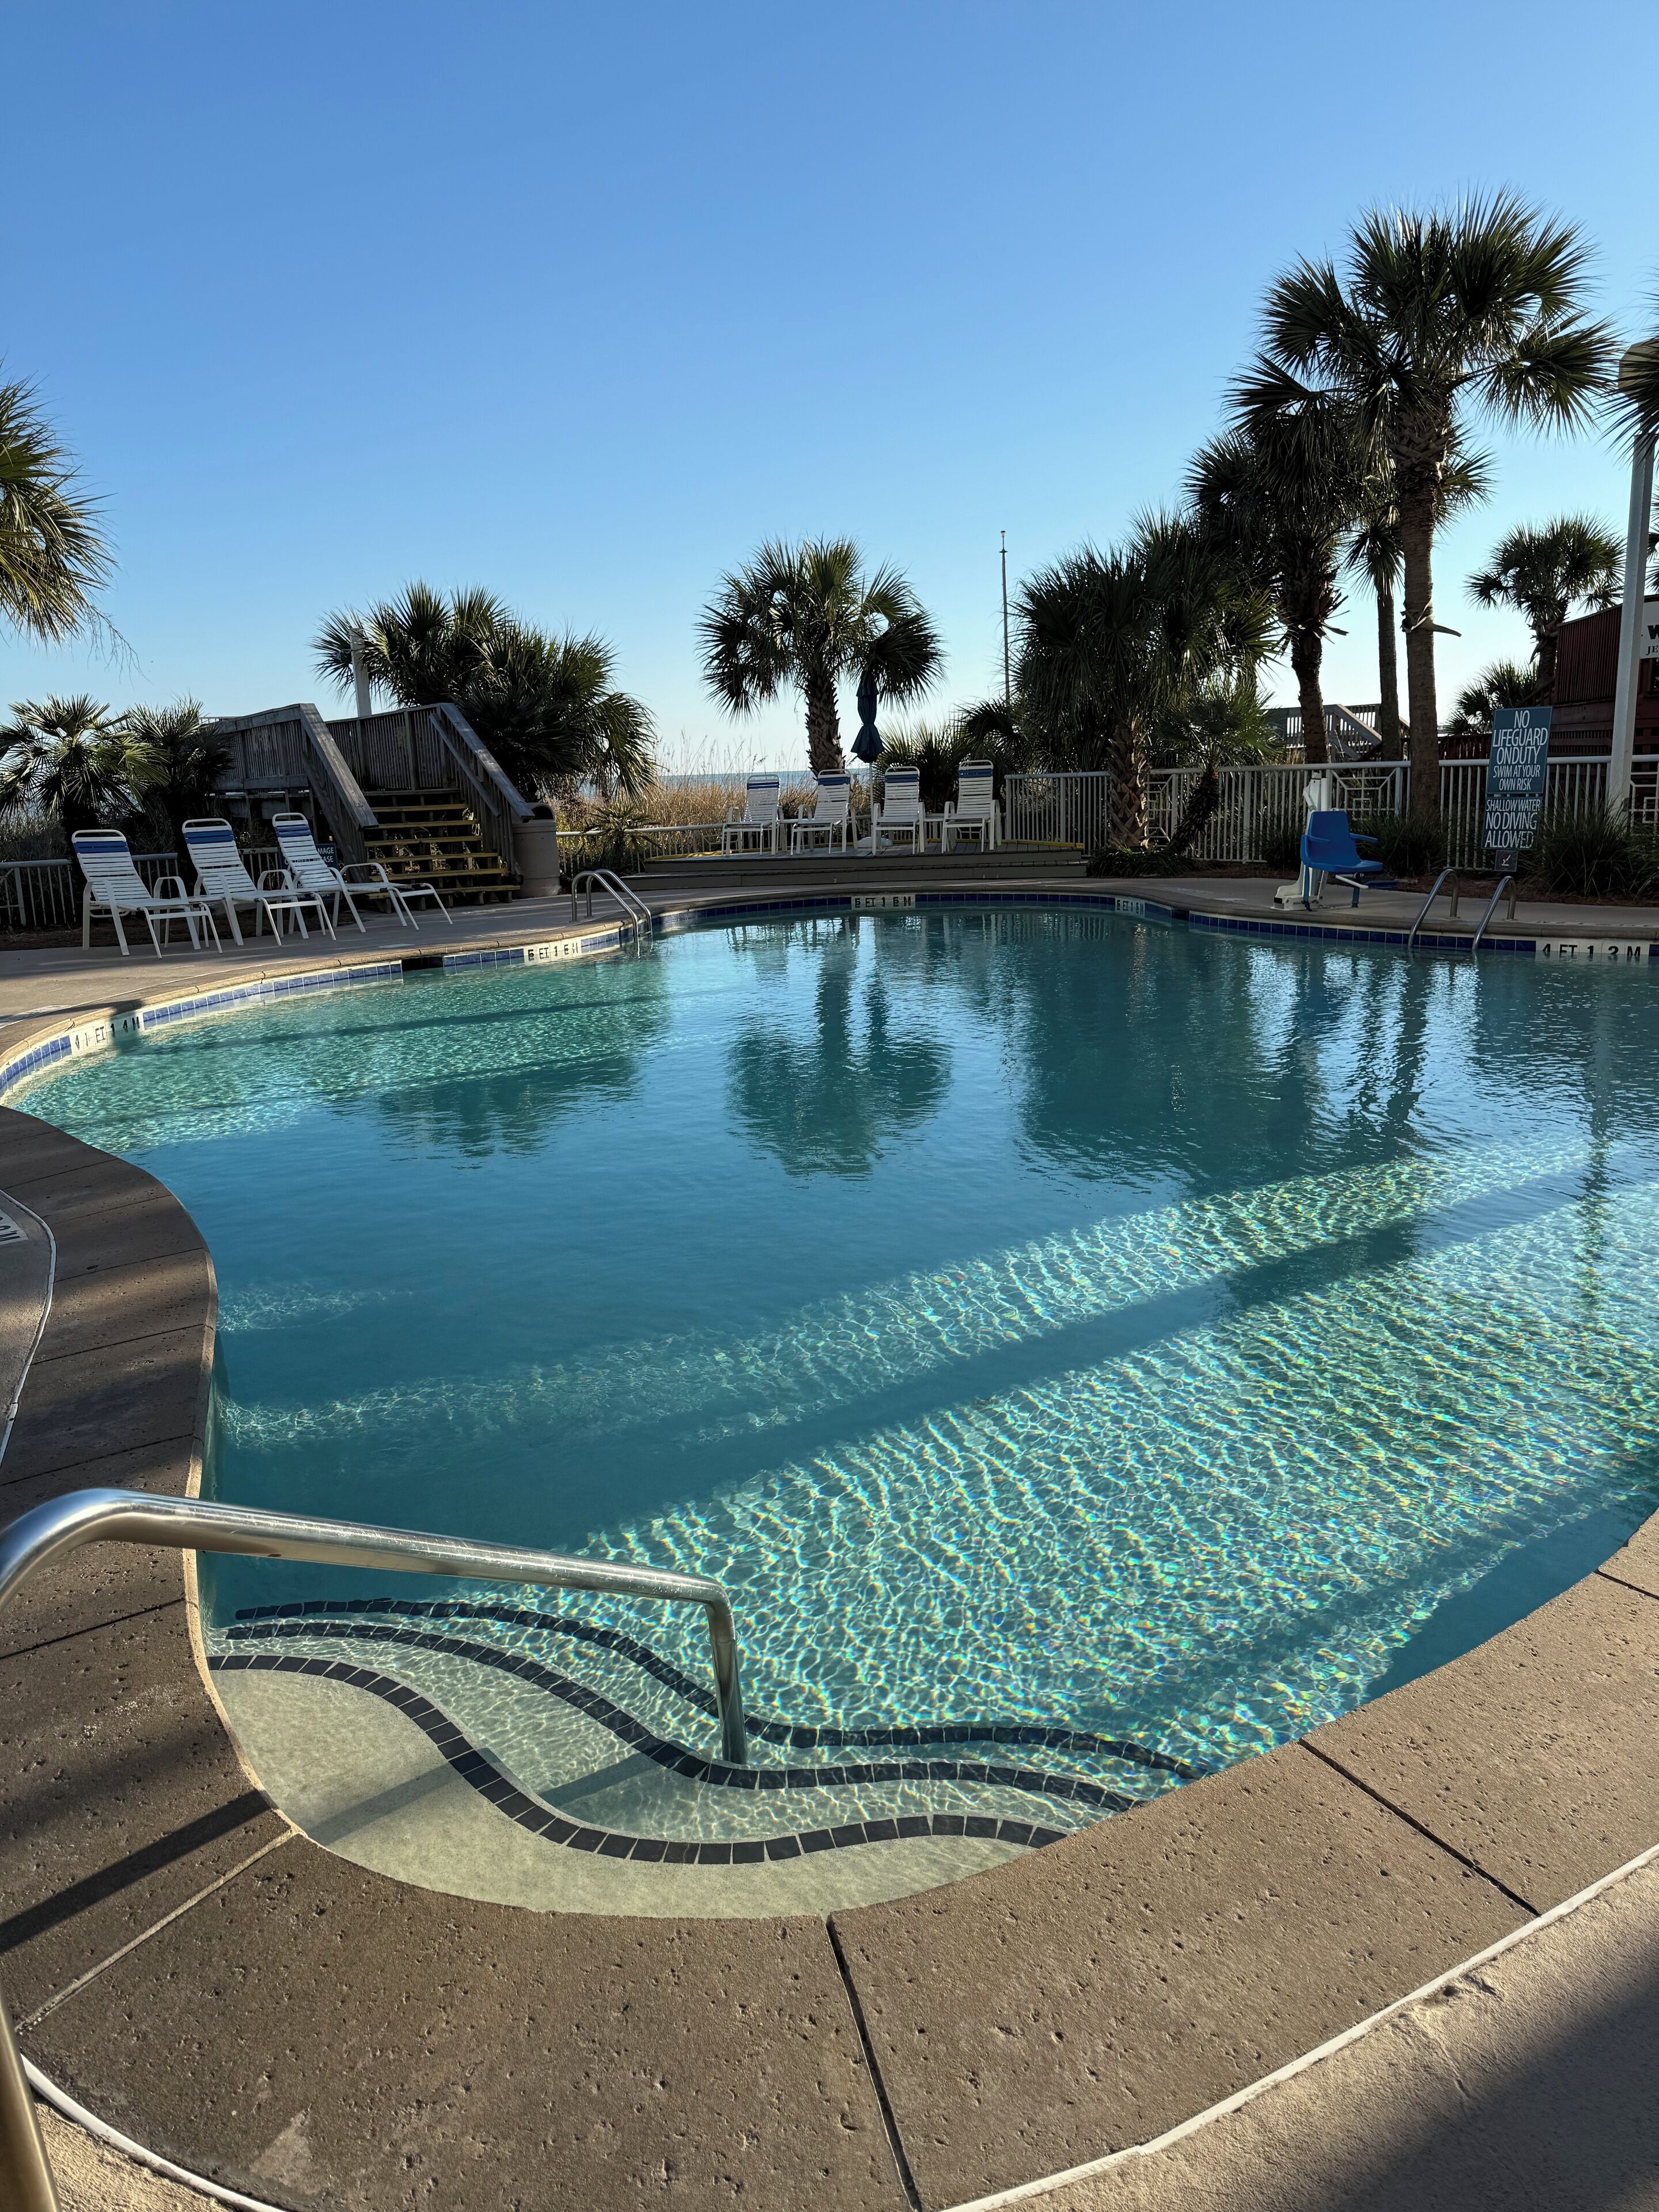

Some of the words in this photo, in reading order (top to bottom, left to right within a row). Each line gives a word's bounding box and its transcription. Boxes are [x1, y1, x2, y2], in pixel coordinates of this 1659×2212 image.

[1514, 710, 1530, 729] NO
[1493, 728, 1548, 747] LIFEGUARD
[1493, 765, 1513, 778] SWIM
[1513, 765, 1522, 778] AT
[1522, 764, 1540, 778] YOUR
[1499, 778, 1516, 791] OWN
[1516, 778, 1532, 790] RISK
[1486, 799, 1518, 812] SHALLOW
[1518, 799, 1541, 811] WATER
[1486, 812, 1501, 830] NO
[1502, 812, 1537, 830] DIVING
[1484, 830, 1535, 849] ALLOWED
[1559, 944, 1578, 953] FT
[1627, 946, 1641, 956] M
